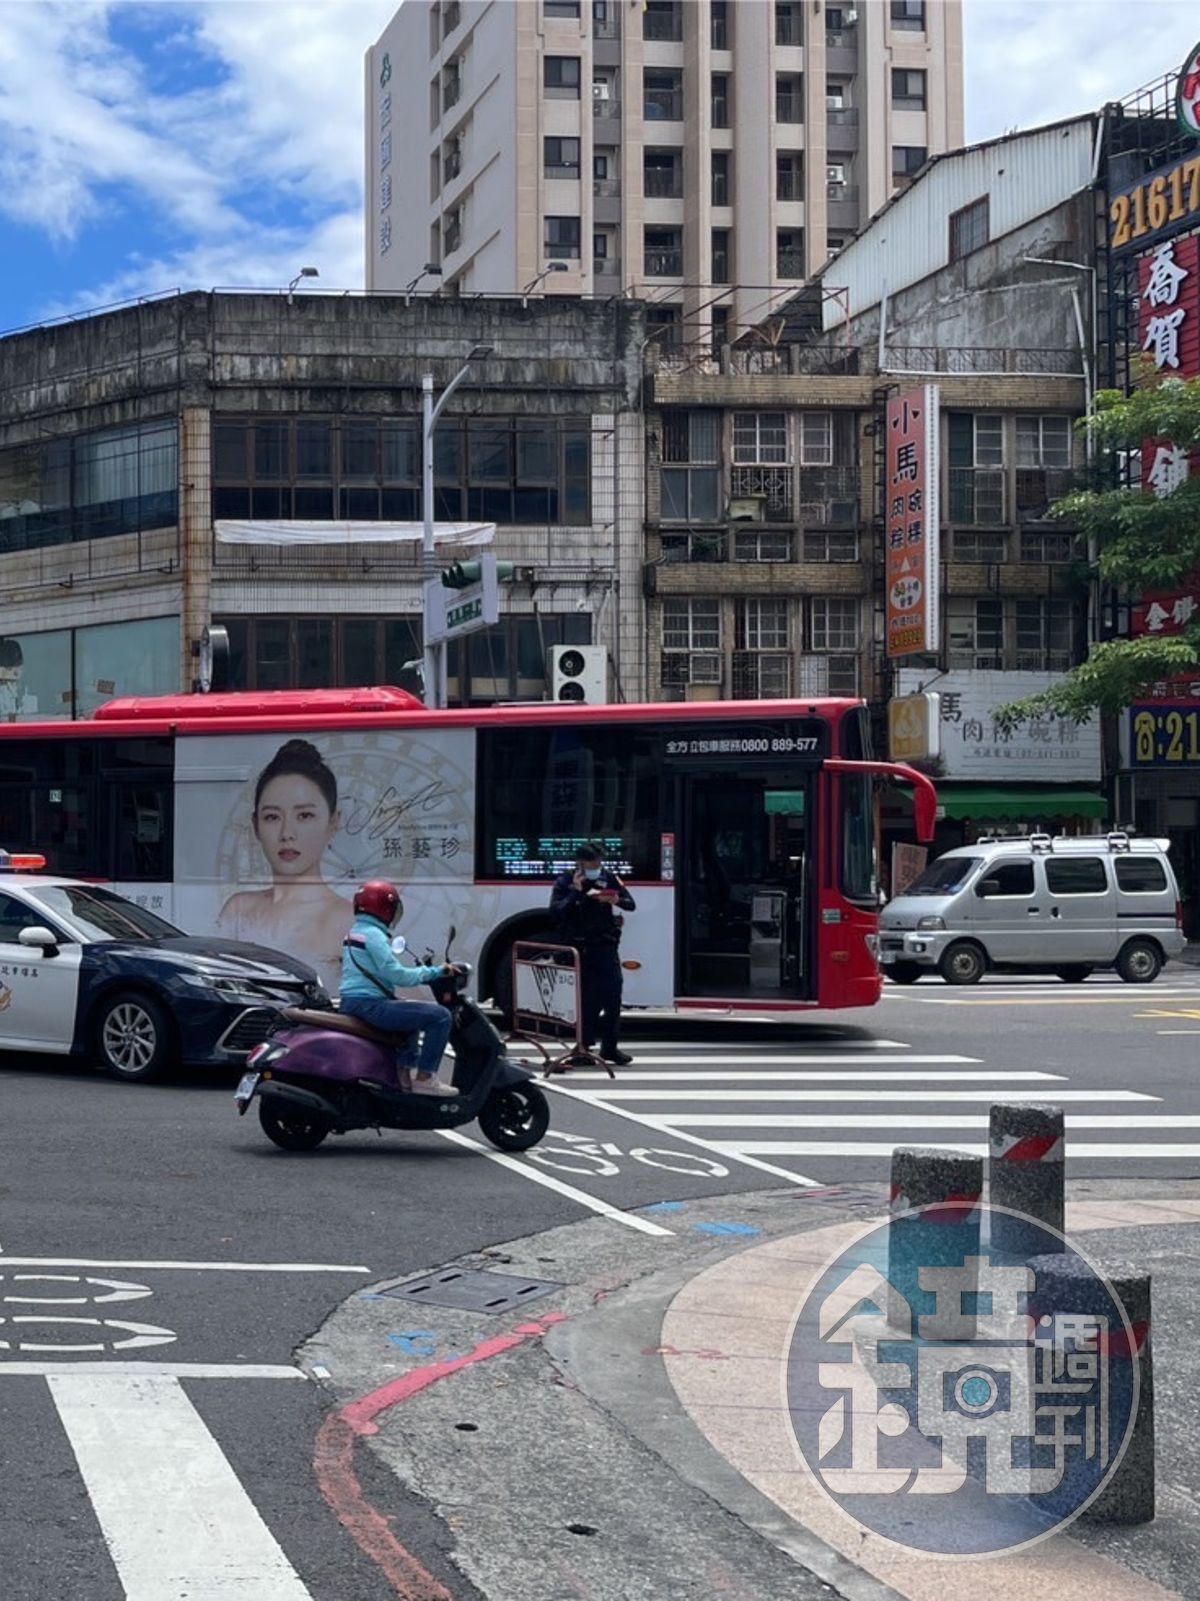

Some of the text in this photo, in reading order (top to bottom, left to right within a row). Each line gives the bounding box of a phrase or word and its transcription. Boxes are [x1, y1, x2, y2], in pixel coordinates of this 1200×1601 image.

[892, 401, 920, 484] 小馬
[772, 737, 818, 751] 889-577
[383, 836, 460, 859] 孫藝珍
